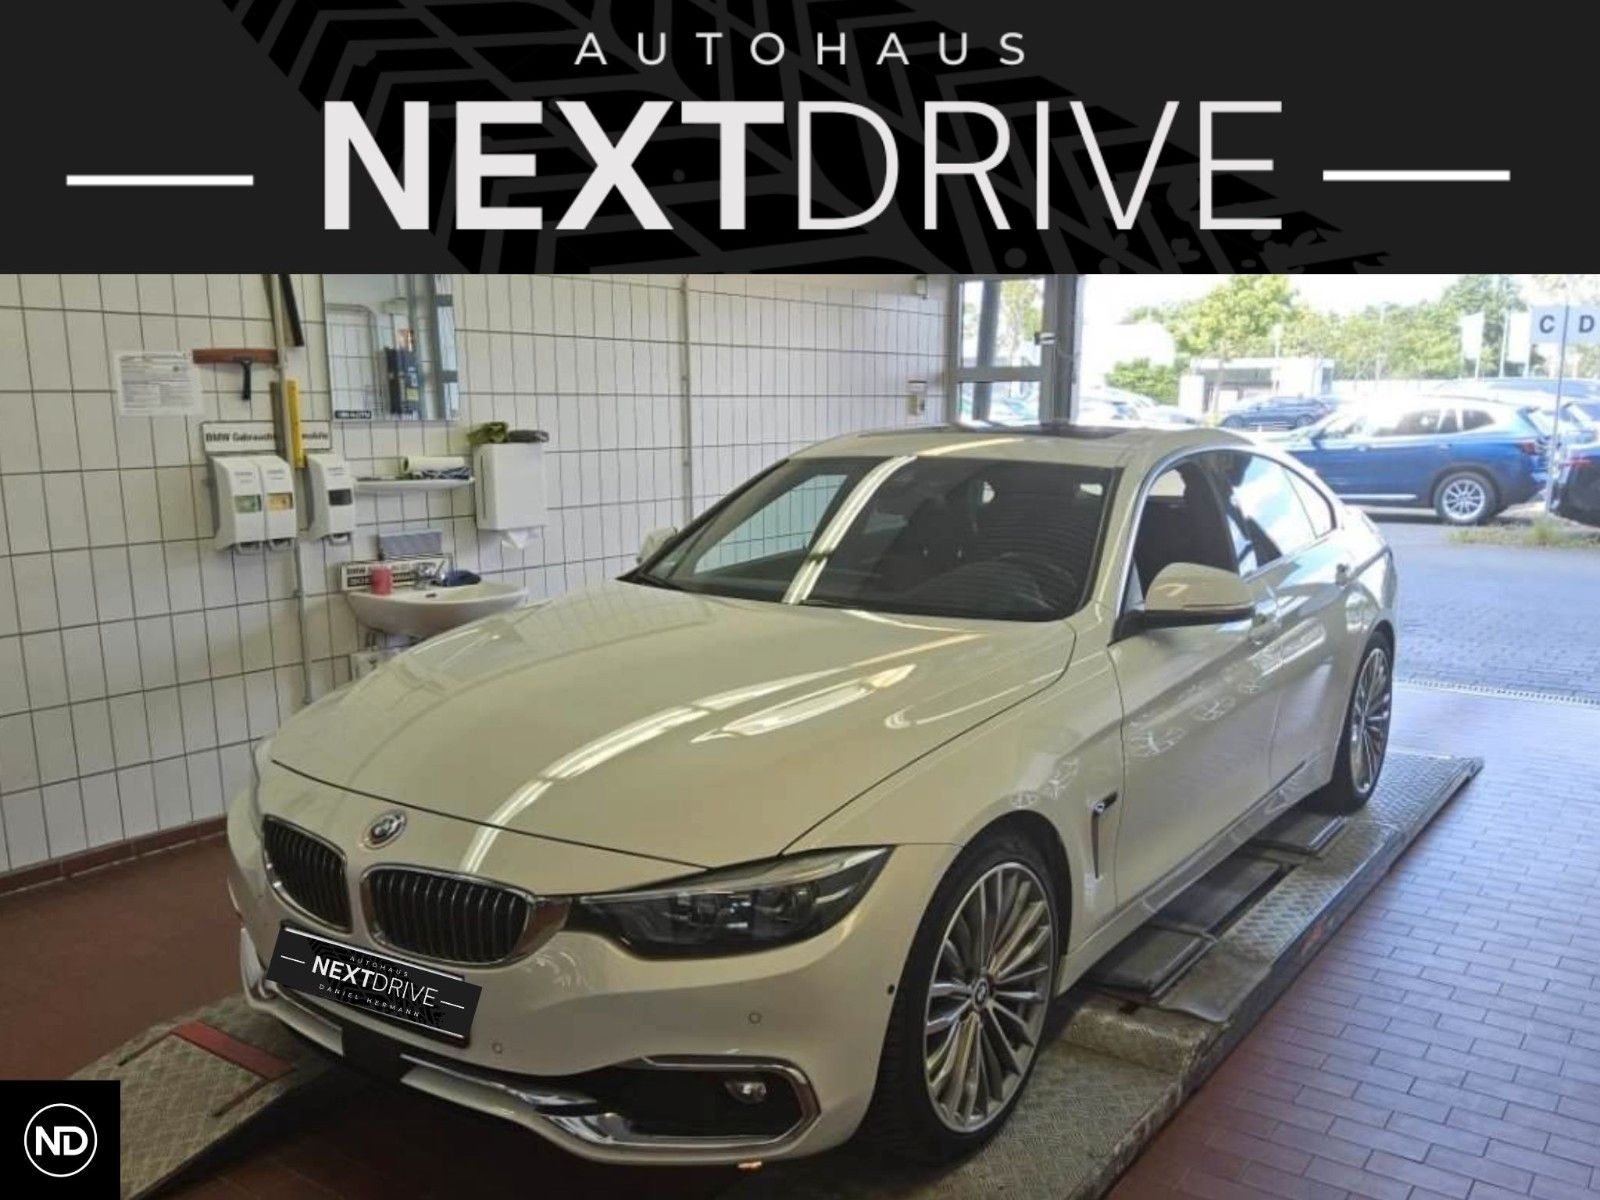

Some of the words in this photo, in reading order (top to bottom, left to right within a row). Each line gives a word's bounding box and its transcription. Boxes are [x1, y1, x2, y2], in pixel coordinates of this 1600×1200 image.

[1539, 315, 1555, 334] C
[1578, 315, 1595, 333] D
[206, 432, 230, 443] BMW
